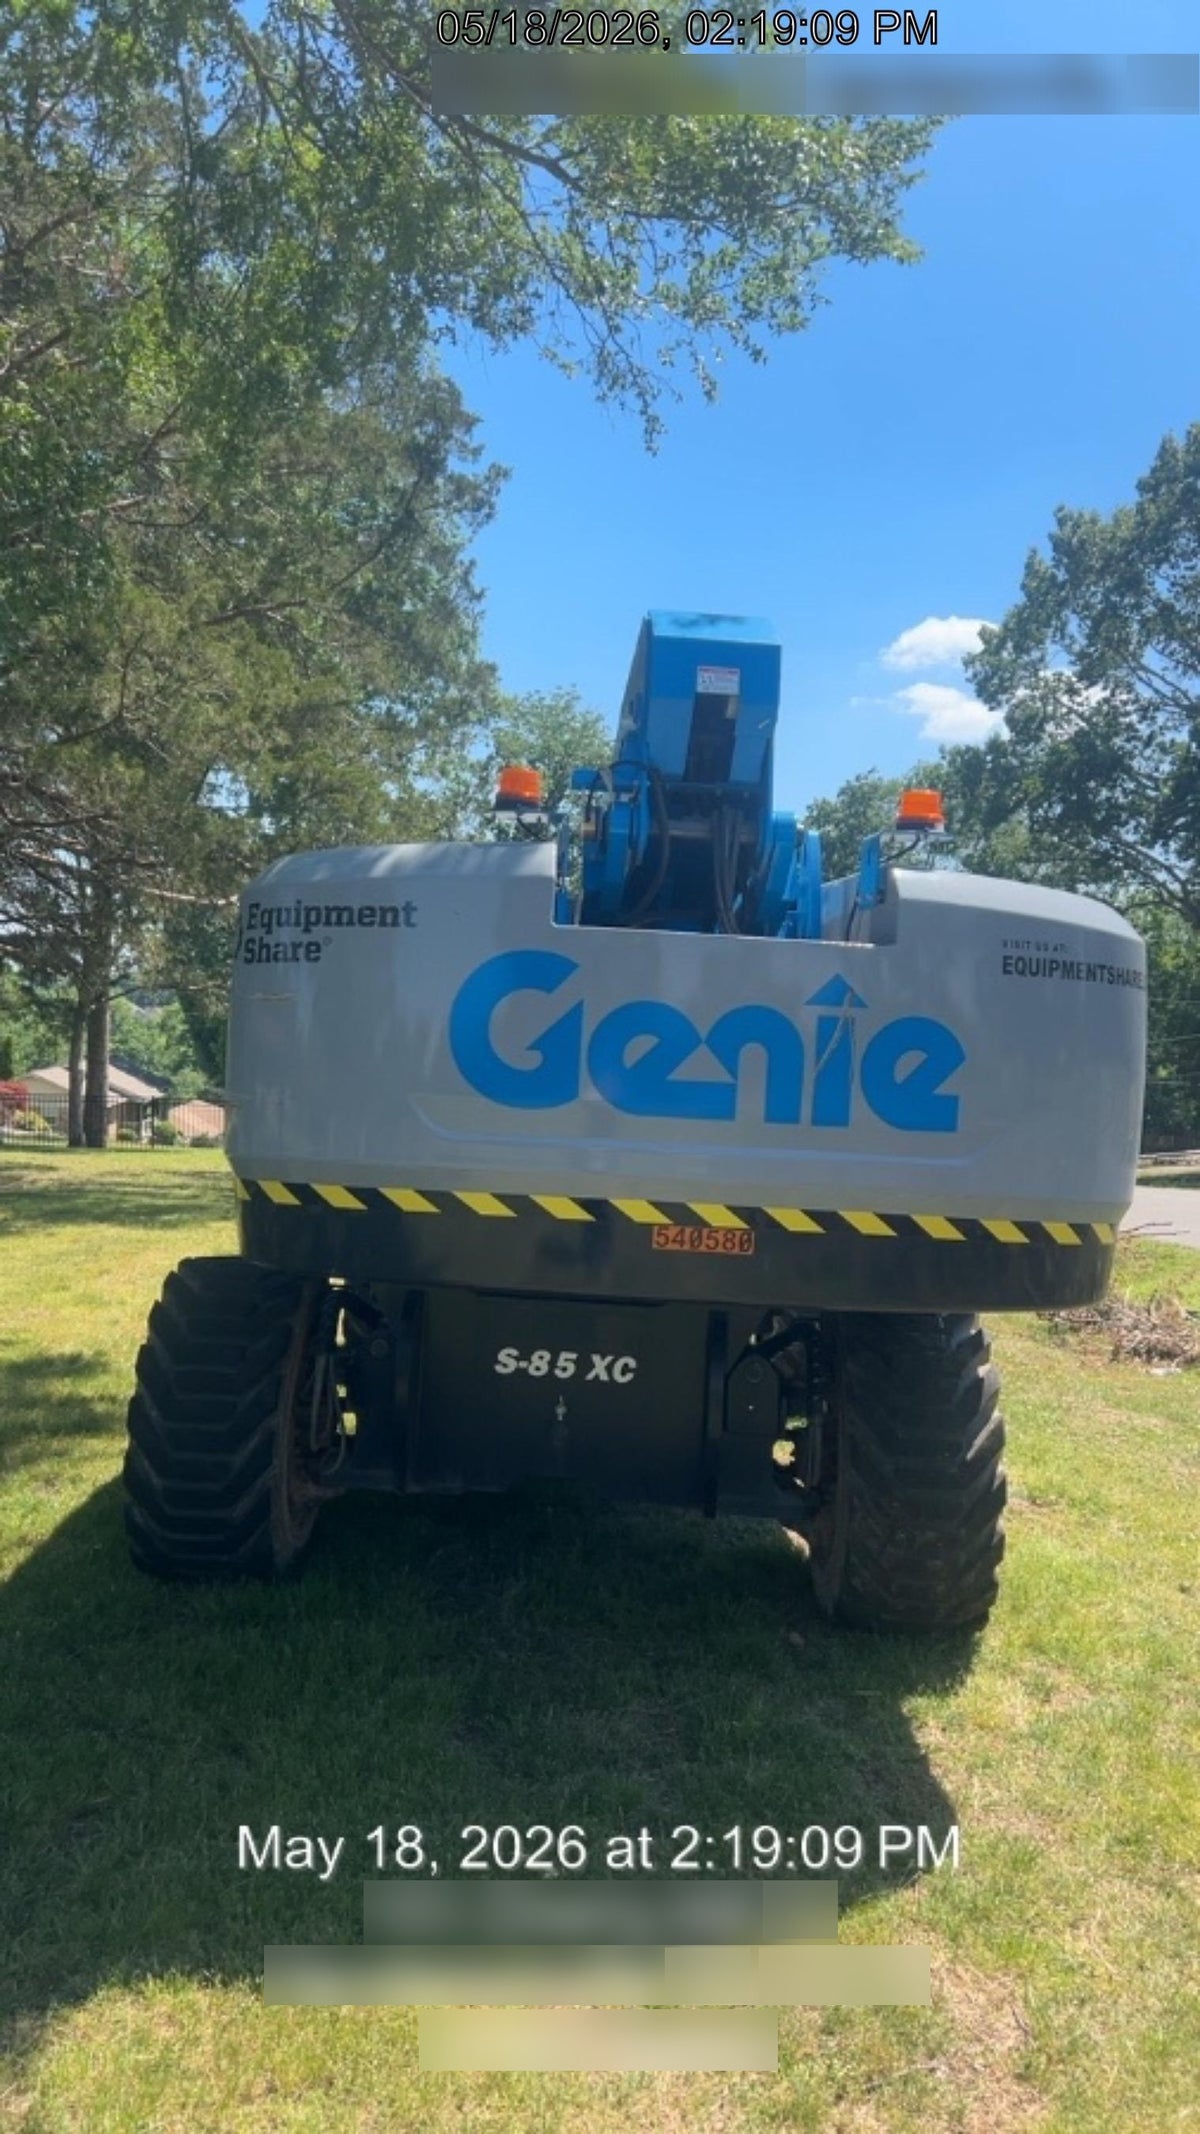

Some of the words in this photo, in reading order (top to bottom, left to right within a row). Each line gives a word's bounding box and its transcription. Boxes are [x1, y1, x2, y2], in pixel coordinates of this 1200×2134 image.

[246, 900, 418, 934] Equipment
[1002, 940, 1031, 950] VISIT
[448, 949, 966, 1133] Genie
[655, 1226, 753, 1253] 540580
[494, 1347, 579, 1379] S-85
[586, 1354, 638, 1384] XC
